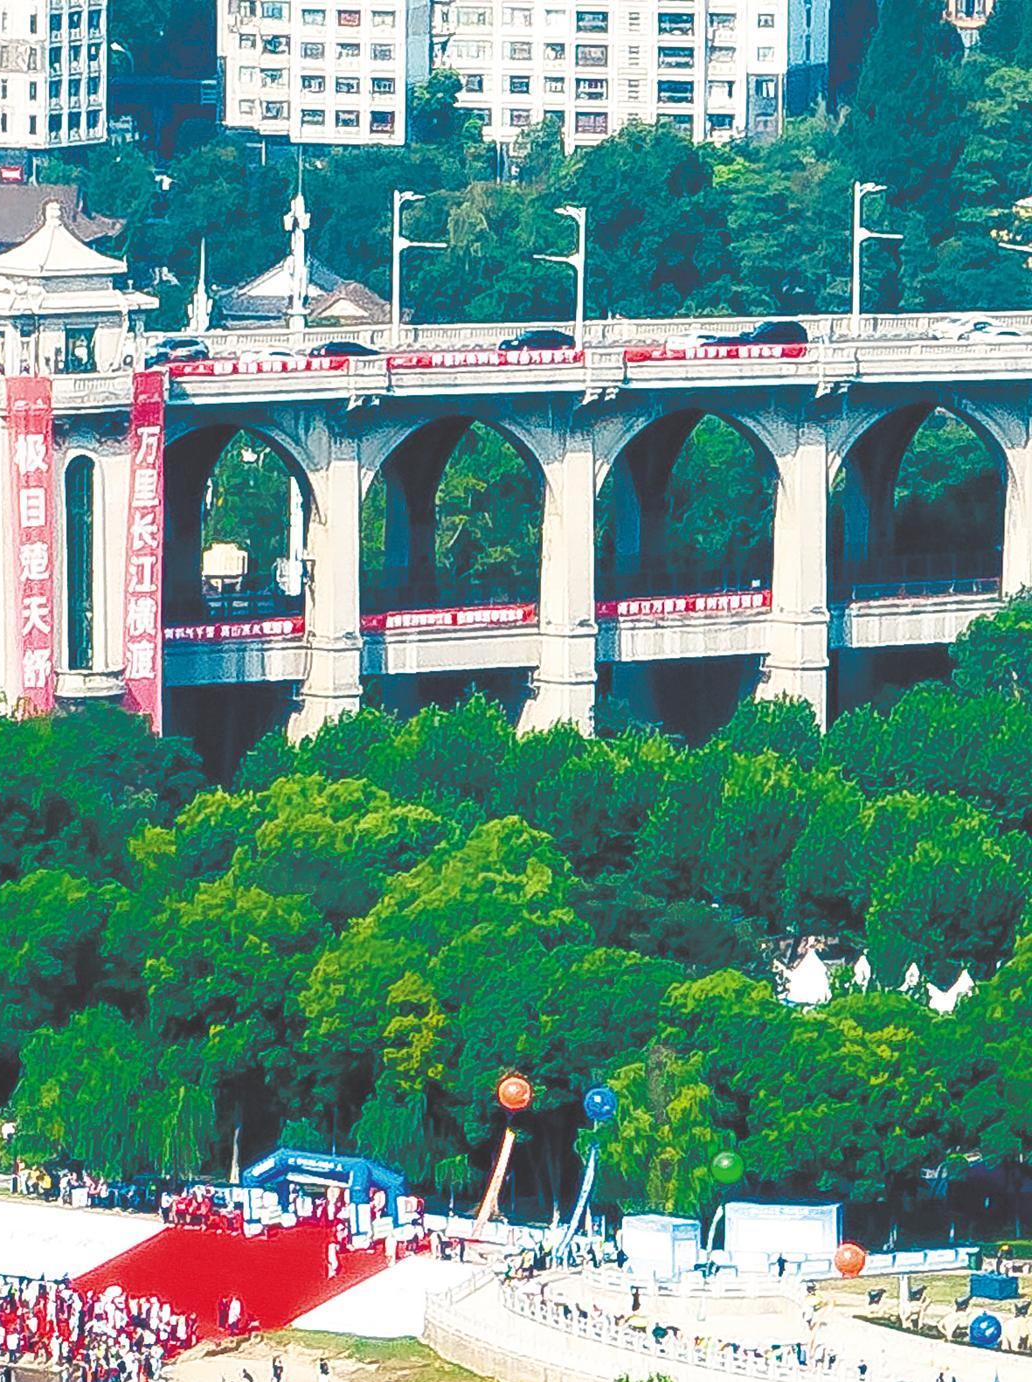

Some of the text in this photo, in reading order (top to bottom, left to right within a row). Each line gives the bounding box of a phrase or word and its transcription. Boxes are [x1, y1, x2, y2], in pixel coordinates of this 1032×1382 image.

[125, 425, 161, 680] 万里长江横渡
